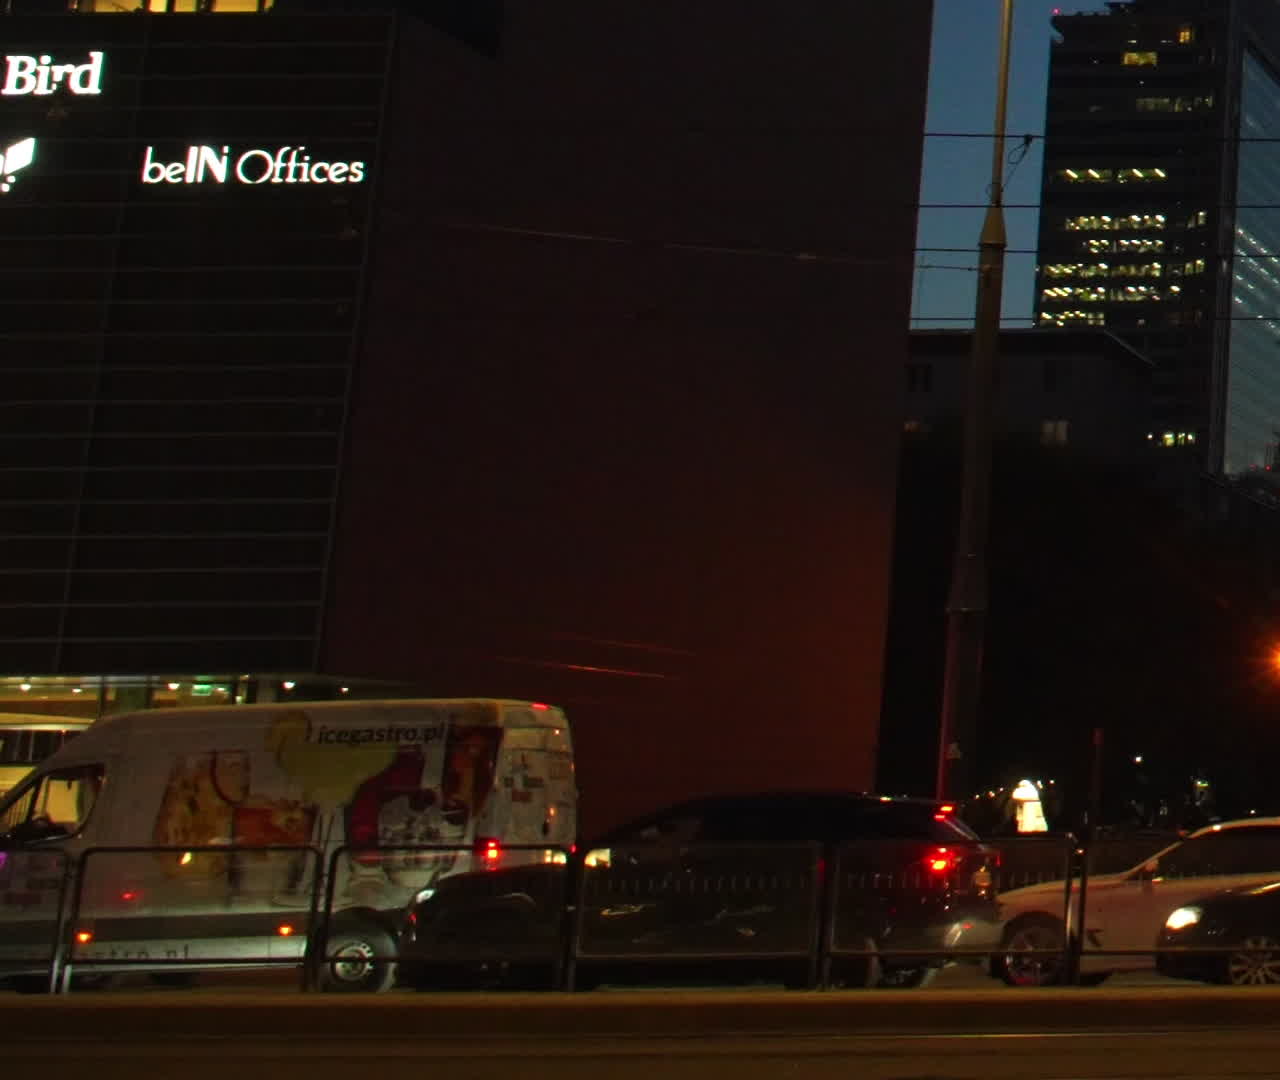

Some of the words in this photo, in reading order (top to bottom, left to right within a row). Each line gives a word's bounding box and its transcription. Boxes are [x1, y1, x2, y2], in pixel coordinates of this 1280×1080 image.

[1, 51, 104, 96] Bird
[235, 145, 365, 184] Offices
[318, 721, 445, 747] icegastro.pl
